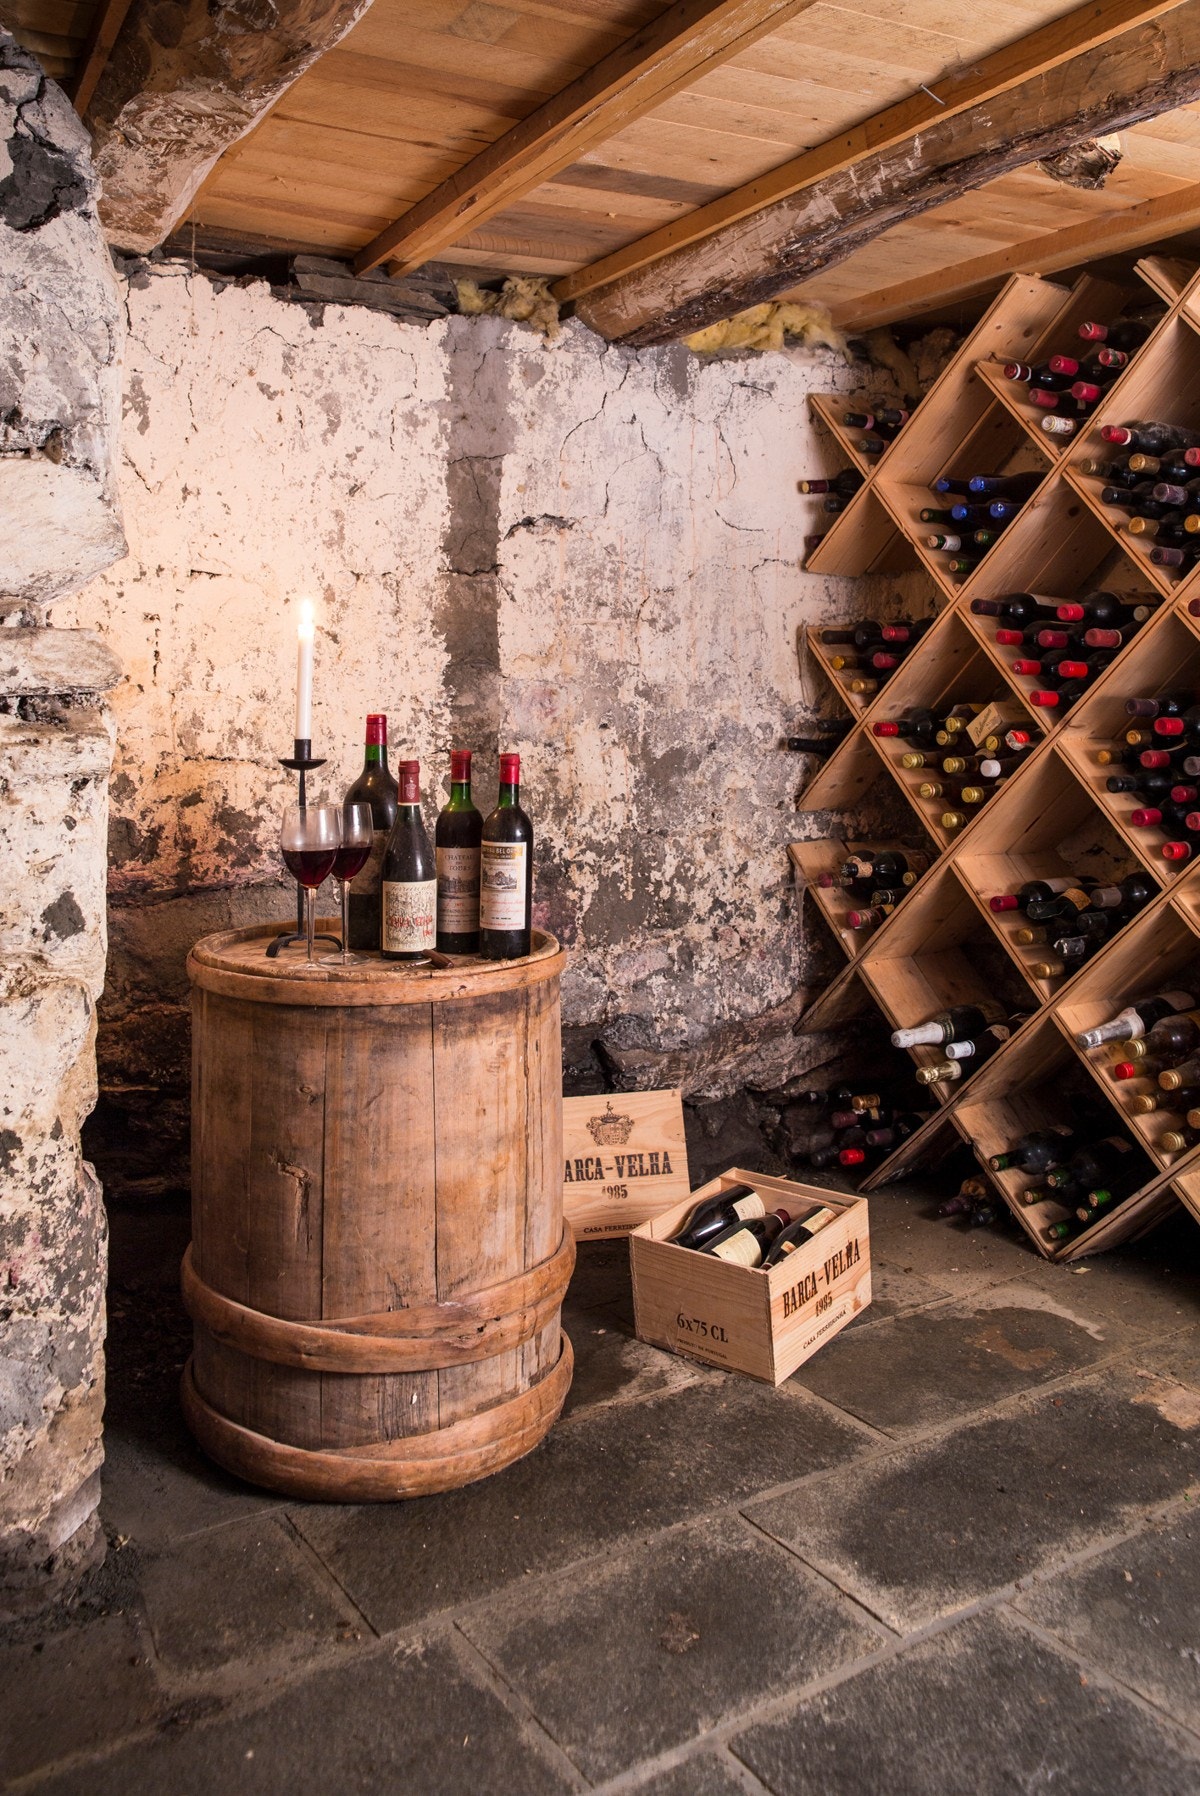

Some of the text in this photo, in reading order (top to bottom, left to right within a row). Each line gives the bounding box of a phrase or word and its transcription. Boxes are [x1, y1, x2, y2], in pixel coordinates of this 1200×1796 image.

[563, 1151, 673, 1183] ARCA-VELHA
[584, 1225, 602, 1234] CASA
[783, 1238, 861, 1319] BARCA-VELHA
[815, 1292, 833, 1318] 1985
[677, 1313, 729, 1343] 6x75 CL
[803, 1334, 816, 1349] CASA
